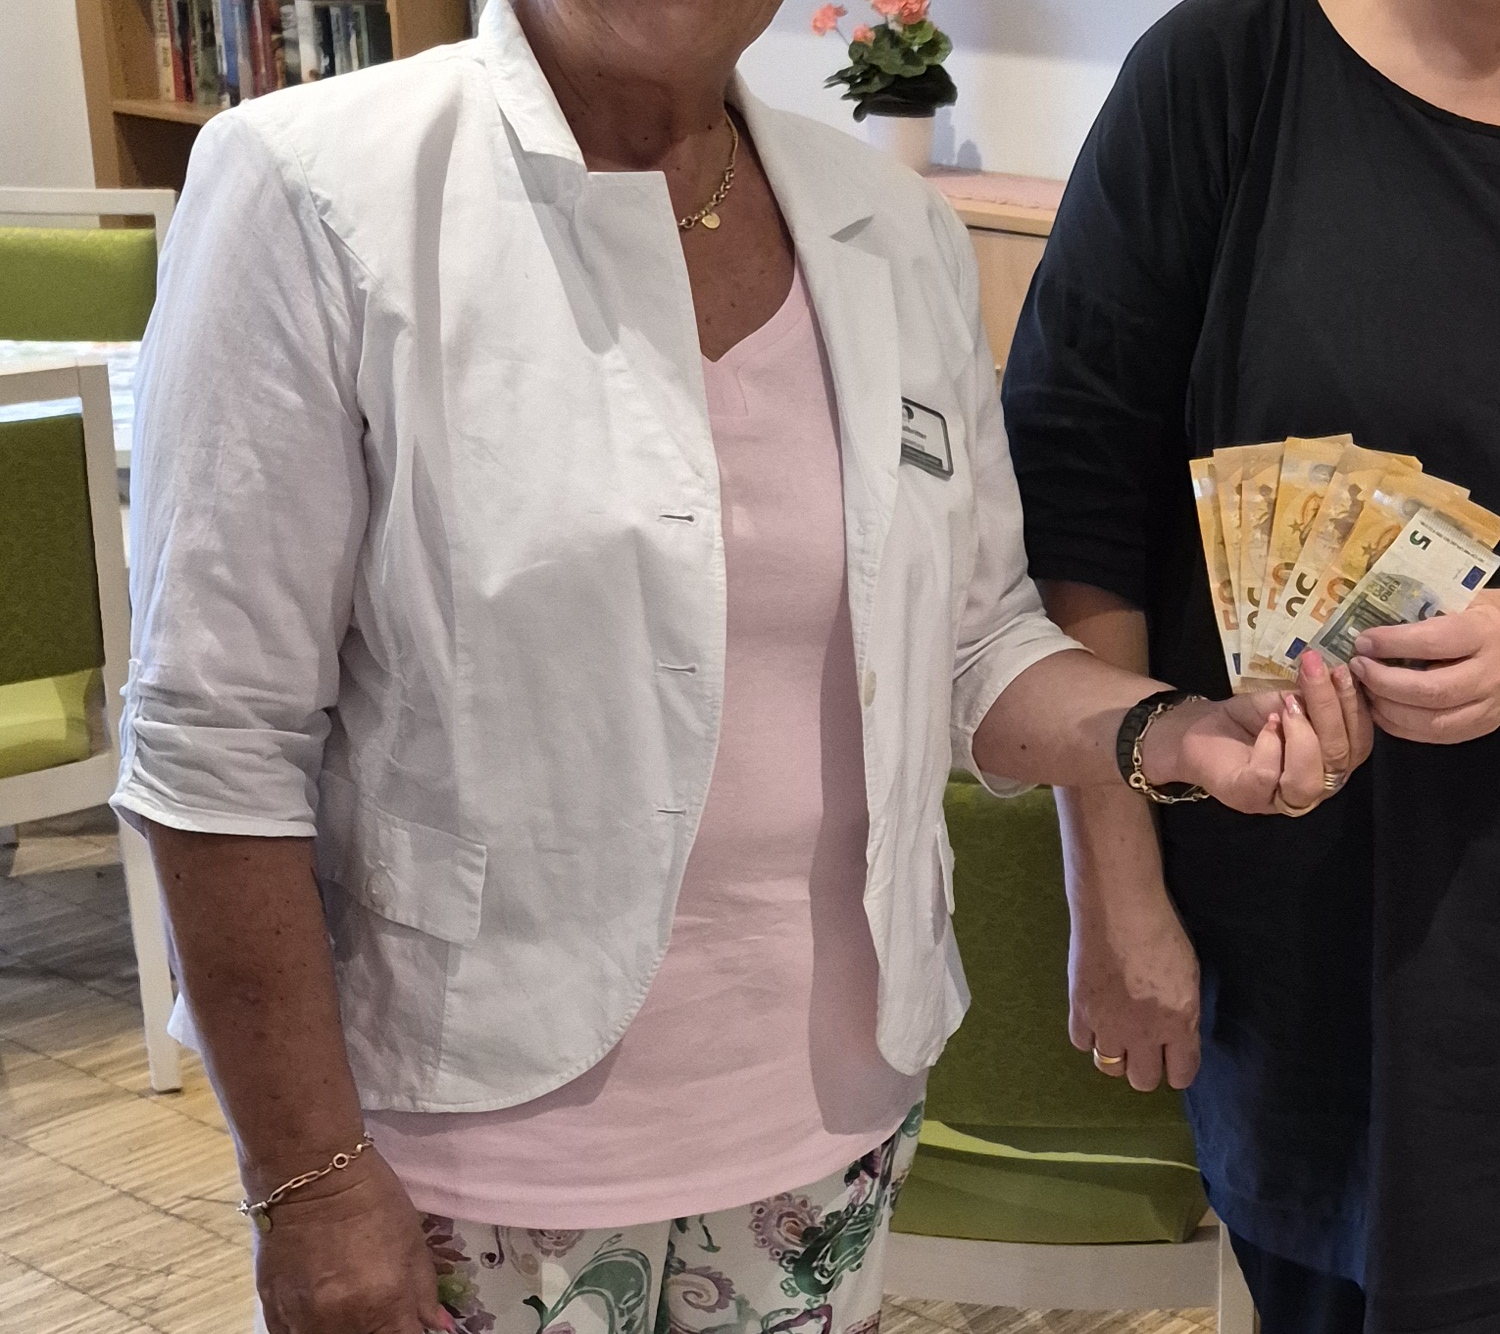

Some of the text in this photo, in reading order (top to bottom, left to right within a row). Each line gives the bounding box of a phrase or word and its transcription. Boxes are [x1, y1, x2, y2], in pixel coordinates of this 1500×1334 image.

[1409, 530, 1432, 551] 5
[1310, 577, 1358, 624] 50
[1380, 579, 1402, 602] EURO
